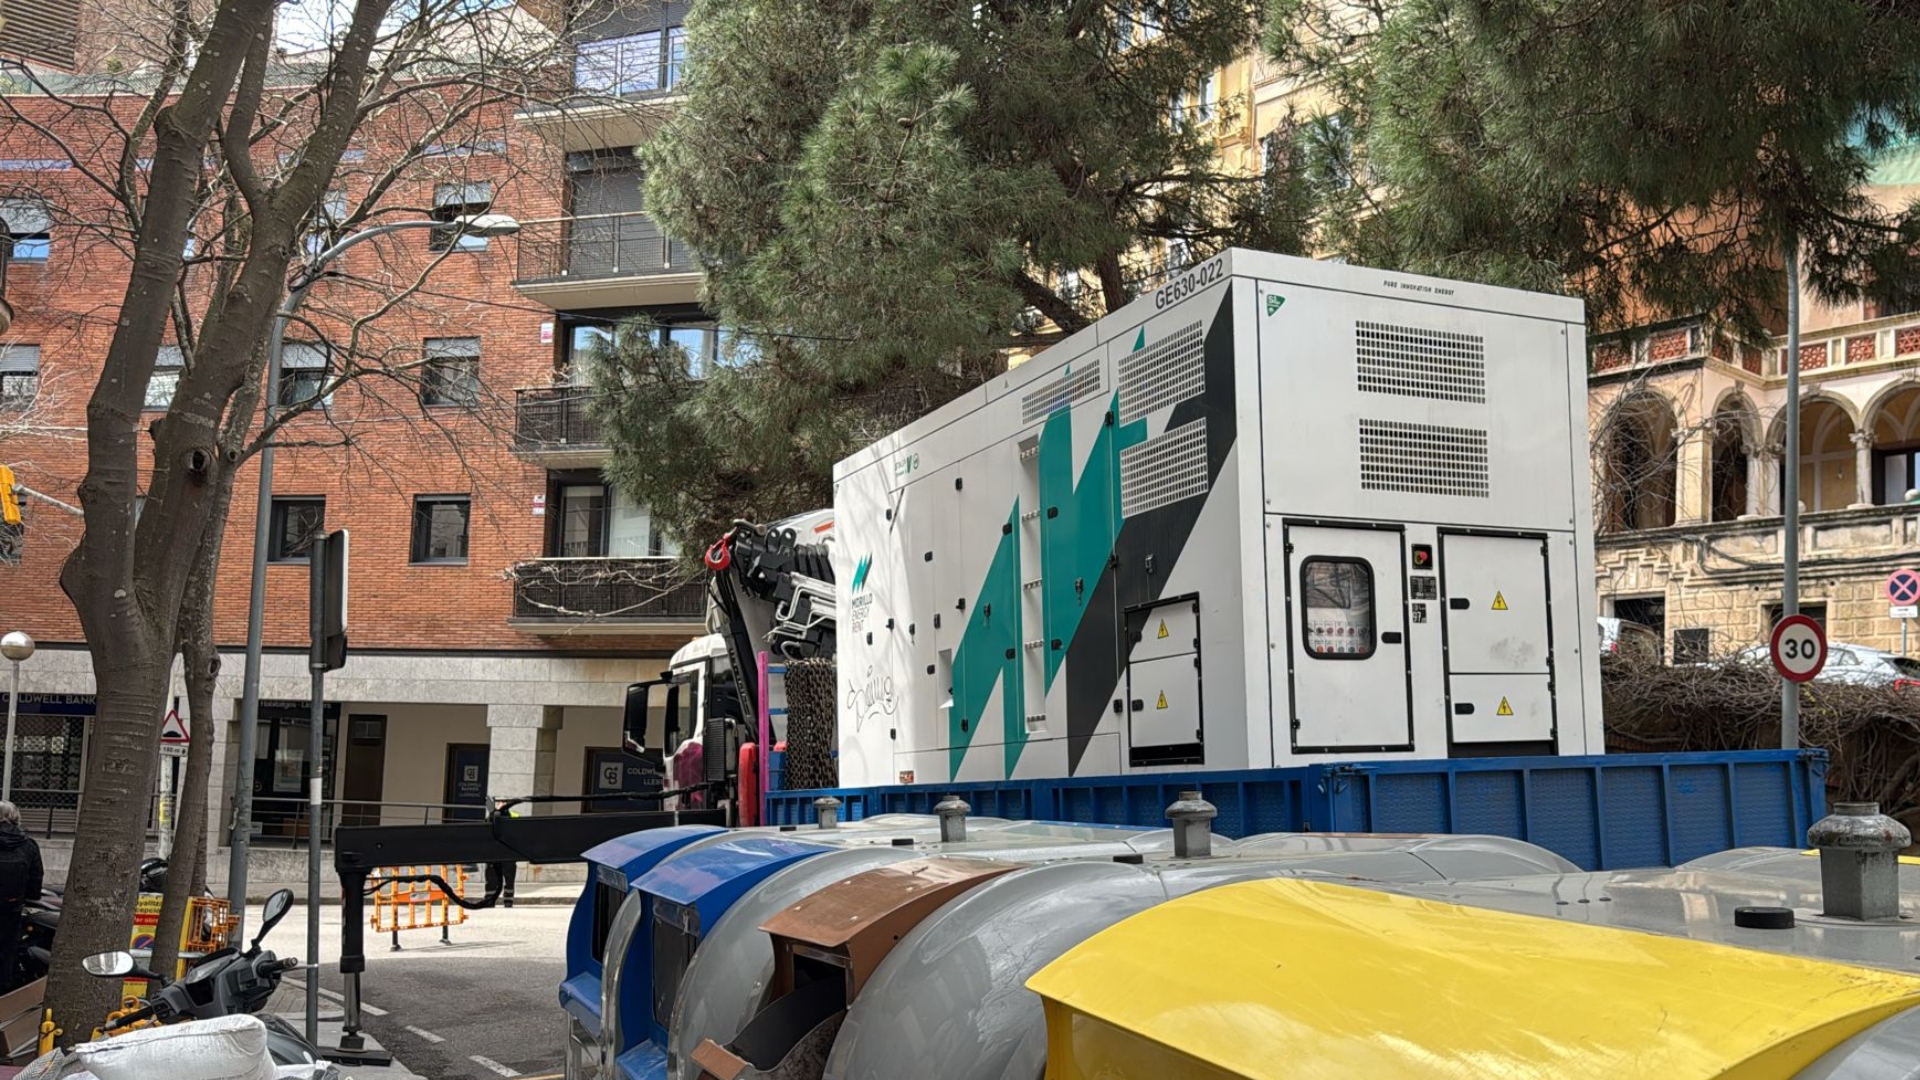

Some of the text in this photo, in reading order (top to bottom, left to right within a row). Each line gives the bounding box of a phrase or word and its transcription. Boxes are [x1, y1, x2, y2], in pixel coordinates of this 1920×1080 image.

[1155, 258, 1223, 310] GE630-022
[1785, 638, 1816, 660] 30
[1, 693, 63, 705] CLDWELL
